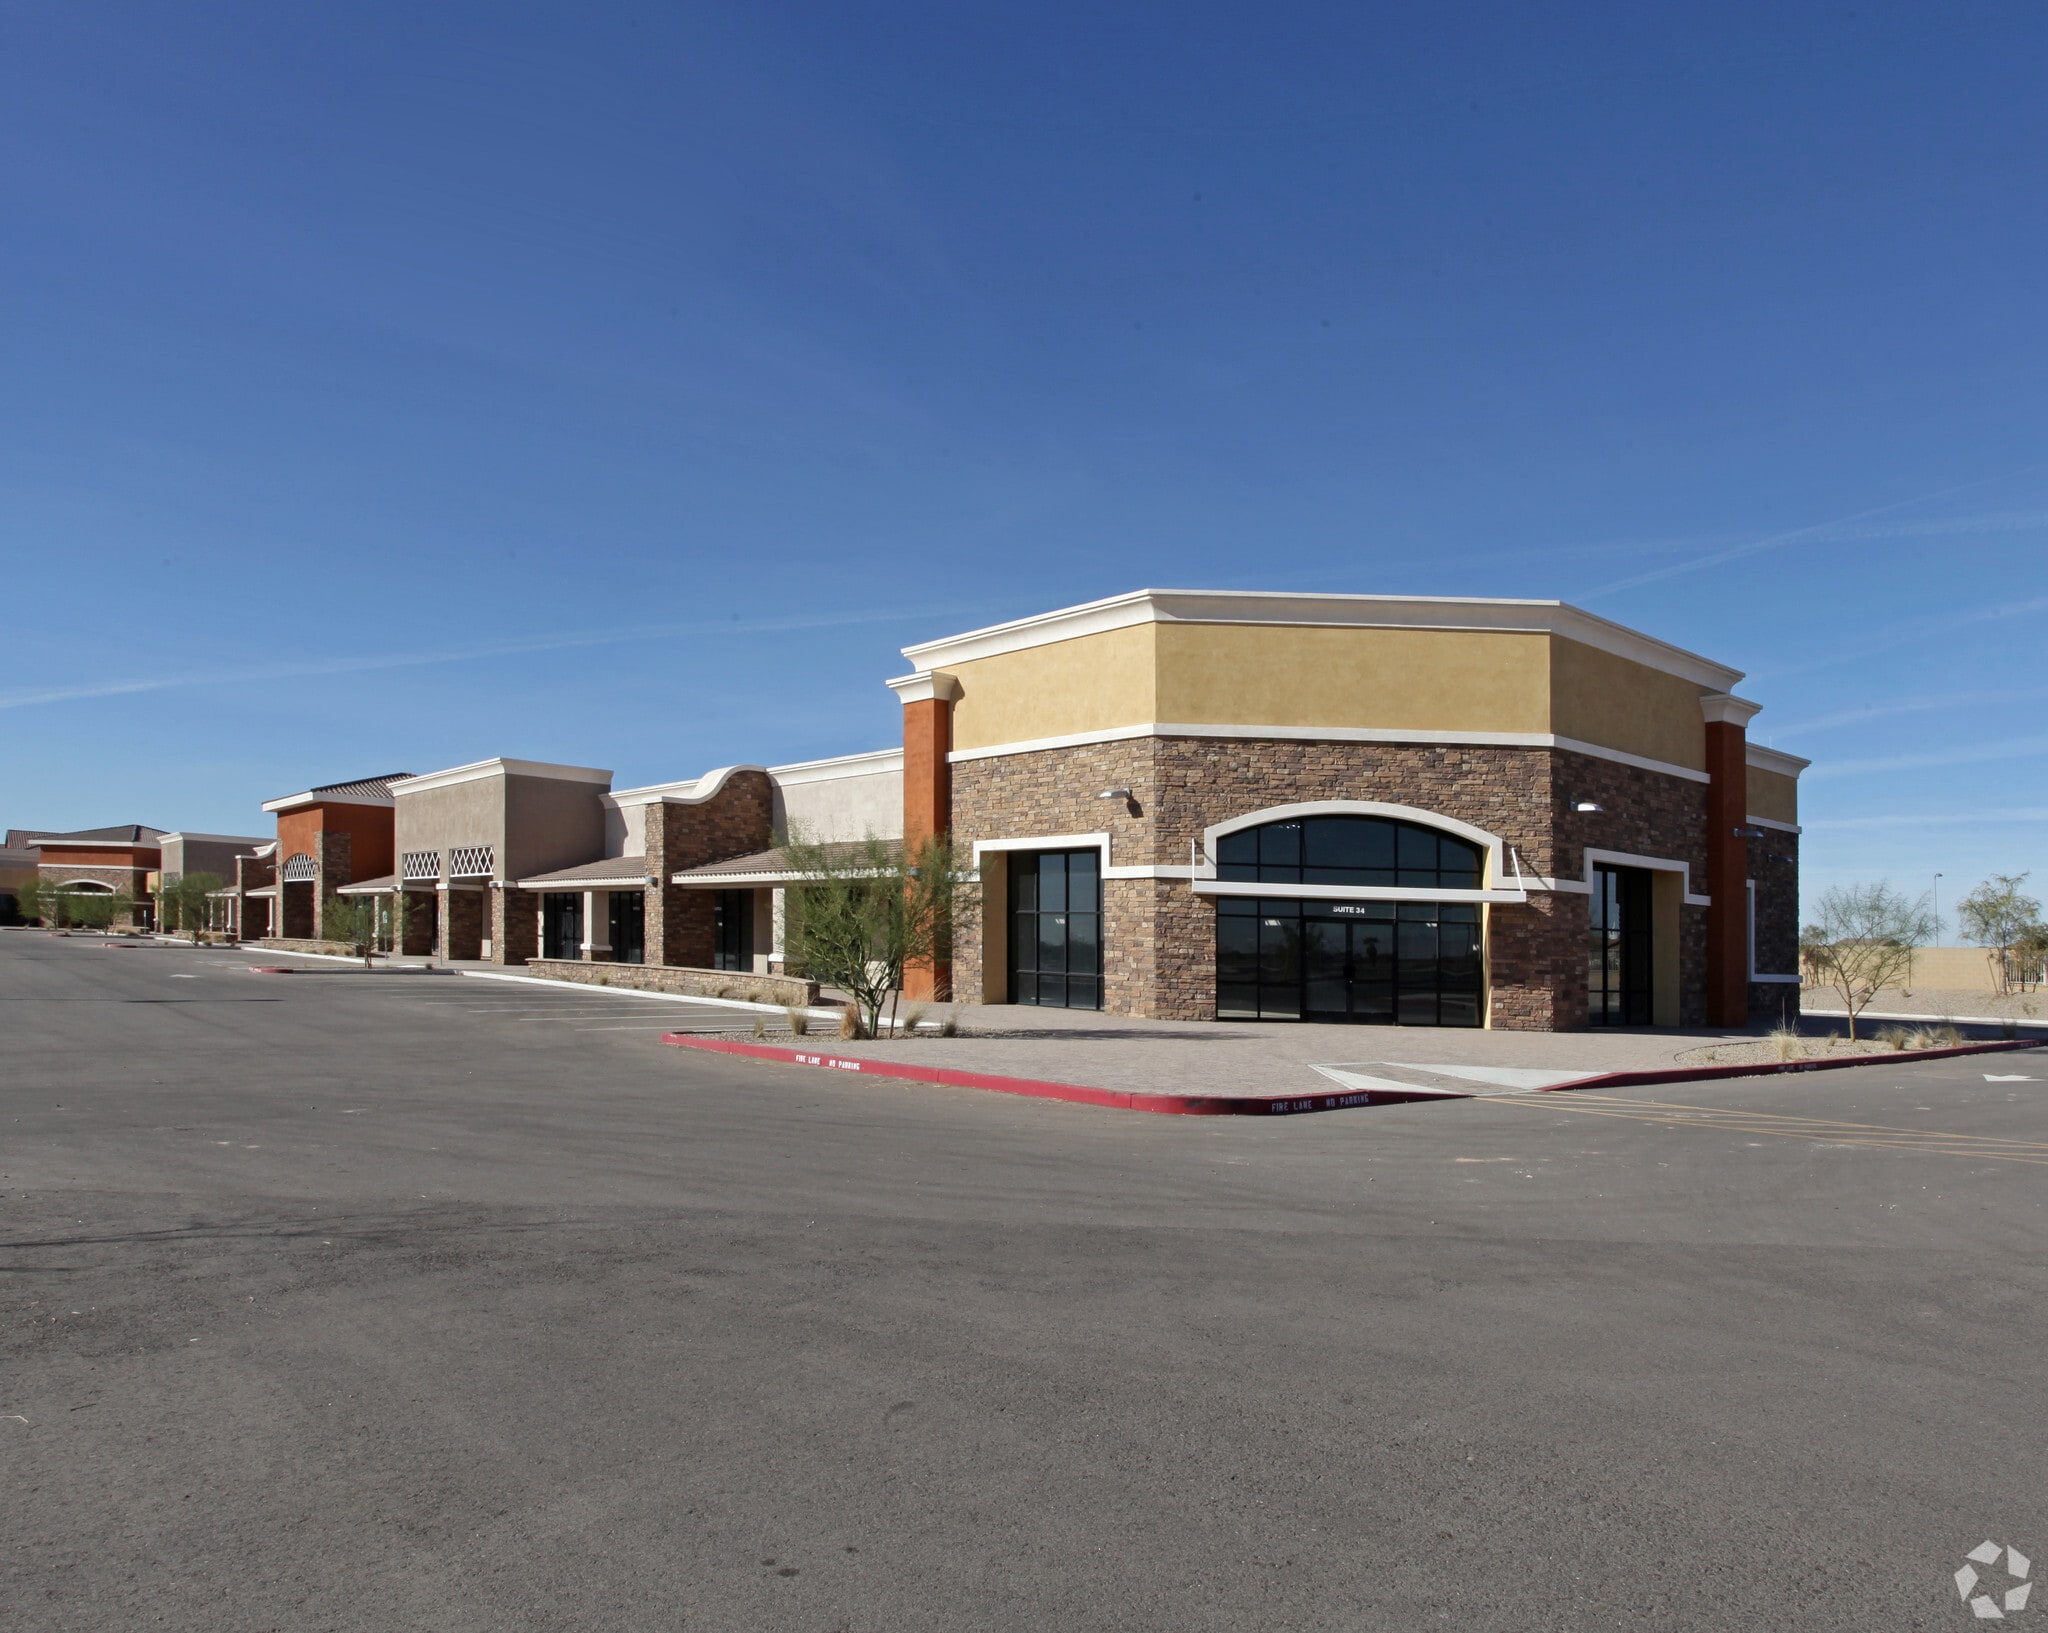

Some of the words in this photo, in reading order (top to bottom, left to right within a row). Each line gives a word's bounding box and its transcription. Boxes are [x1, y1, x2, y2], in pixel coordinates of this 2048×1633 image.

[796, 1054, 806, 1063] FIRE
[808, 1056, 820, 1065] LANE
[828, 1060, 836, 1068] NO
[838, 1060, 860, 1070] PARKING
[1271, 1102, 1288, 1112] FIRE
[1293, 1100, 1312, 1110] LANE
[1326, 1098, 1336, 1108] NO
[1340, 1093, 1369, 1106] PARKING
